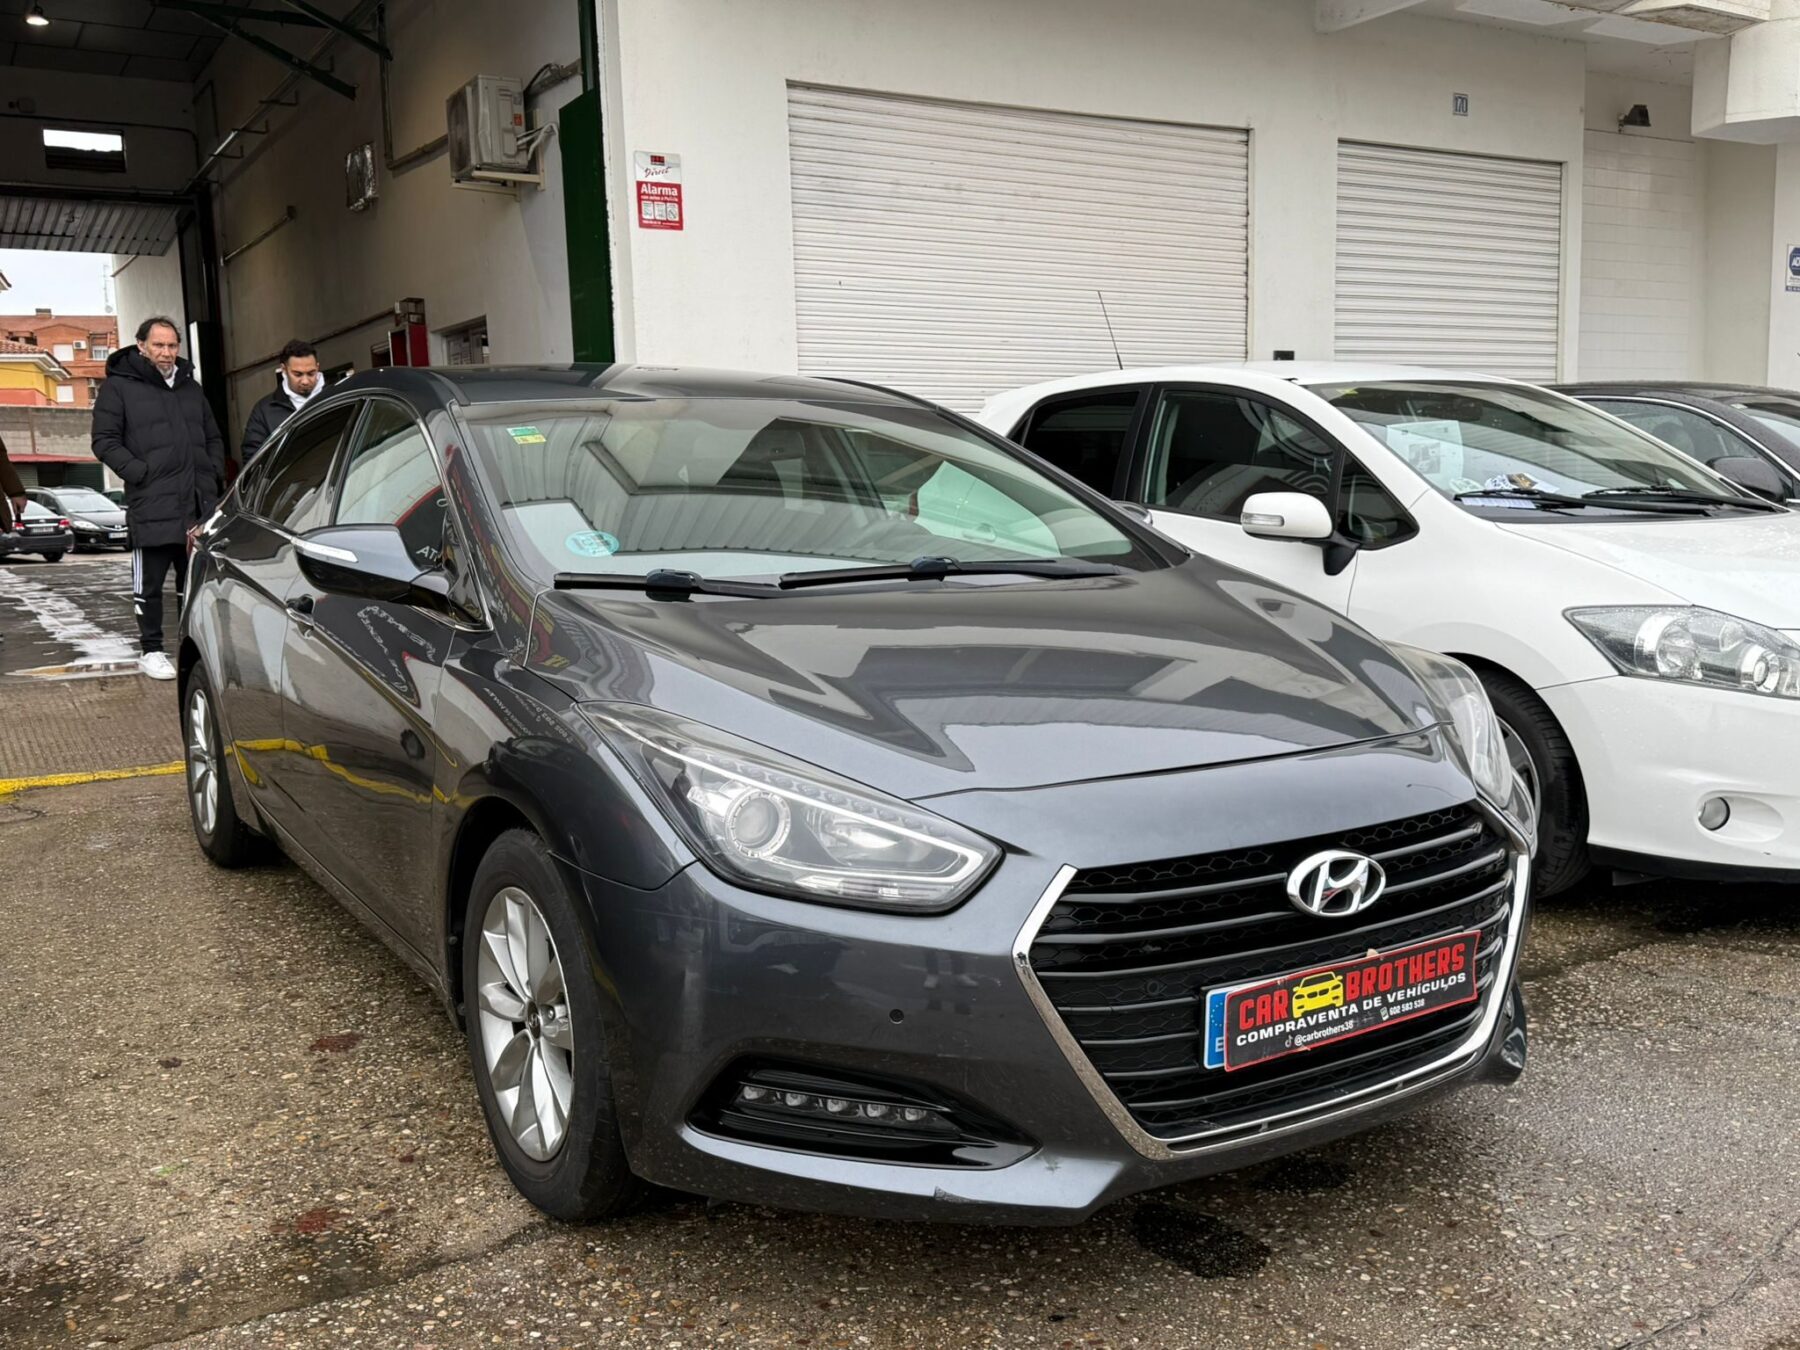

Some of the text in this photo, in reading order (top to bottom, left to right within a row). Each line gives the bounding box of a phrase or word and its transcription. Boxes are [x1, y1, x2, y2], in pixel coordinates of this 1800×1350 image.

[1455, 95, 1468, 113] 170
[641, 183, 678, 196] Alarma
[1239, 943, 1466, 1030] CAR BROTHERS
[1236, 972, 1466, 1046] COMPRAVENTA DE VEHÍCULOS
[1389, 998, 1425, 1016] 602 583 538
[1294, 1020, 1354, 1046] @carbrothers38
